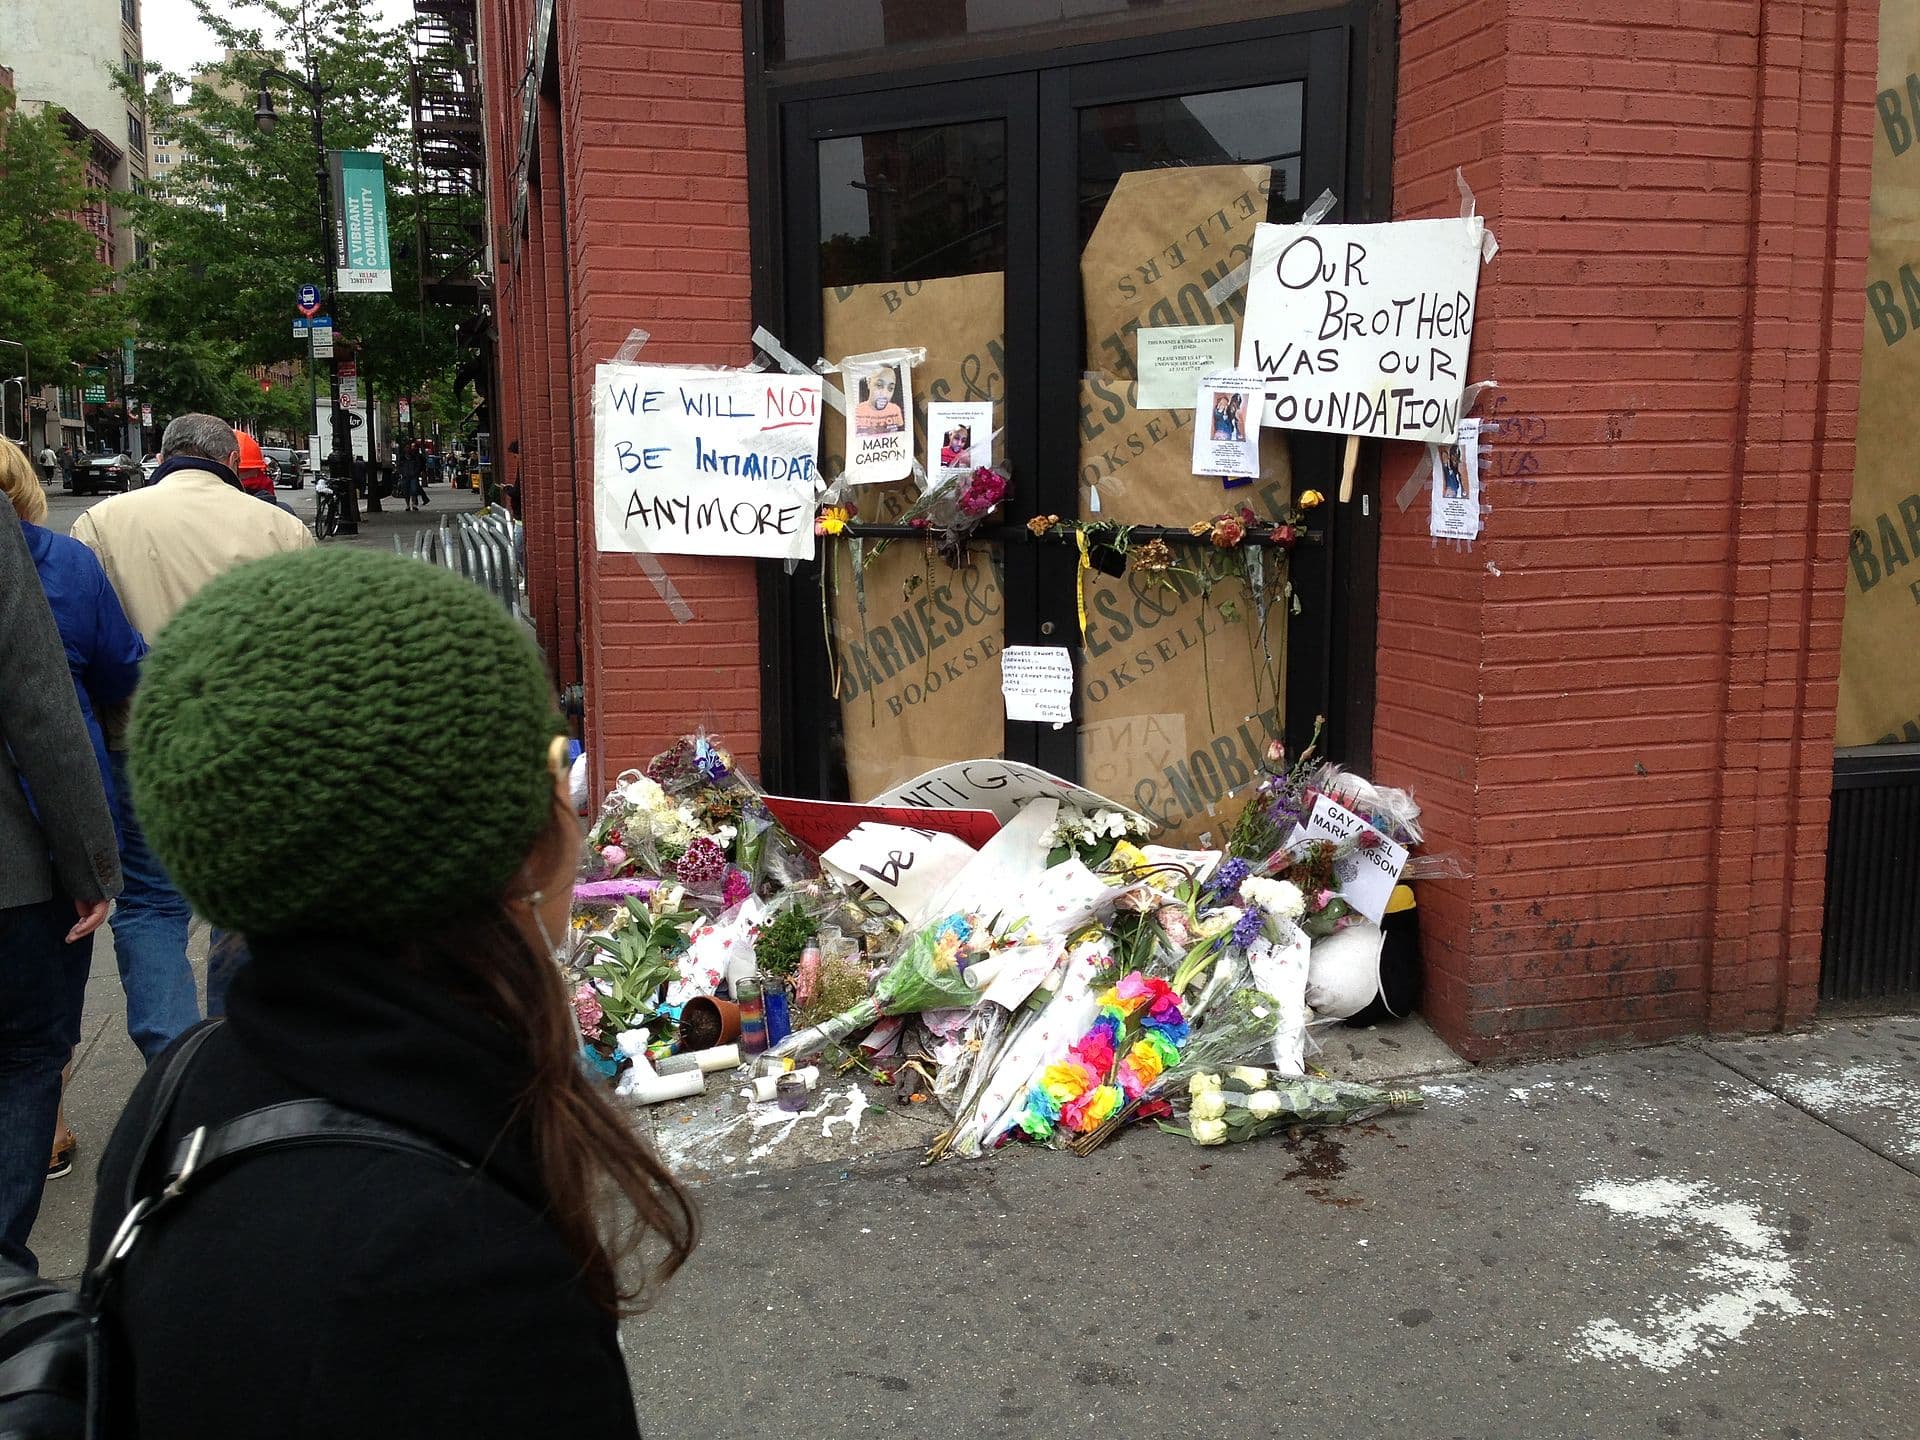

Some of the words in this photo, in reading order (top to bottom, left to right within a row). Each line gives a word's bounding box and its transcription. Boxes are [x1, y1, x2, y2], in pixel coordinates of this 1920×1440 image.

[348, 197, 362, 254] VIBRANT
[361, 187, 377, 267] COMMUNITY
[353, 258, 364, 266] A
[1254, 340, 1340, 375] WAS
[1379, 348, 1456, 380] OUR
[609, 383, 665, 416] WE
[680, 387, 755, 417] WILL
[766, 386, 820, 419] NOT
[615, 440, 671, 473] BE
[855, 449, 906, 465] CARSON
[862, 436, 899, 450] MARK
[625, 489, 802, 535] ANYMORE
[1313, 814, 1349, 840] MARK
[1327, 807, 1354, 828] GAY
[859, 850, 914, 887] be
